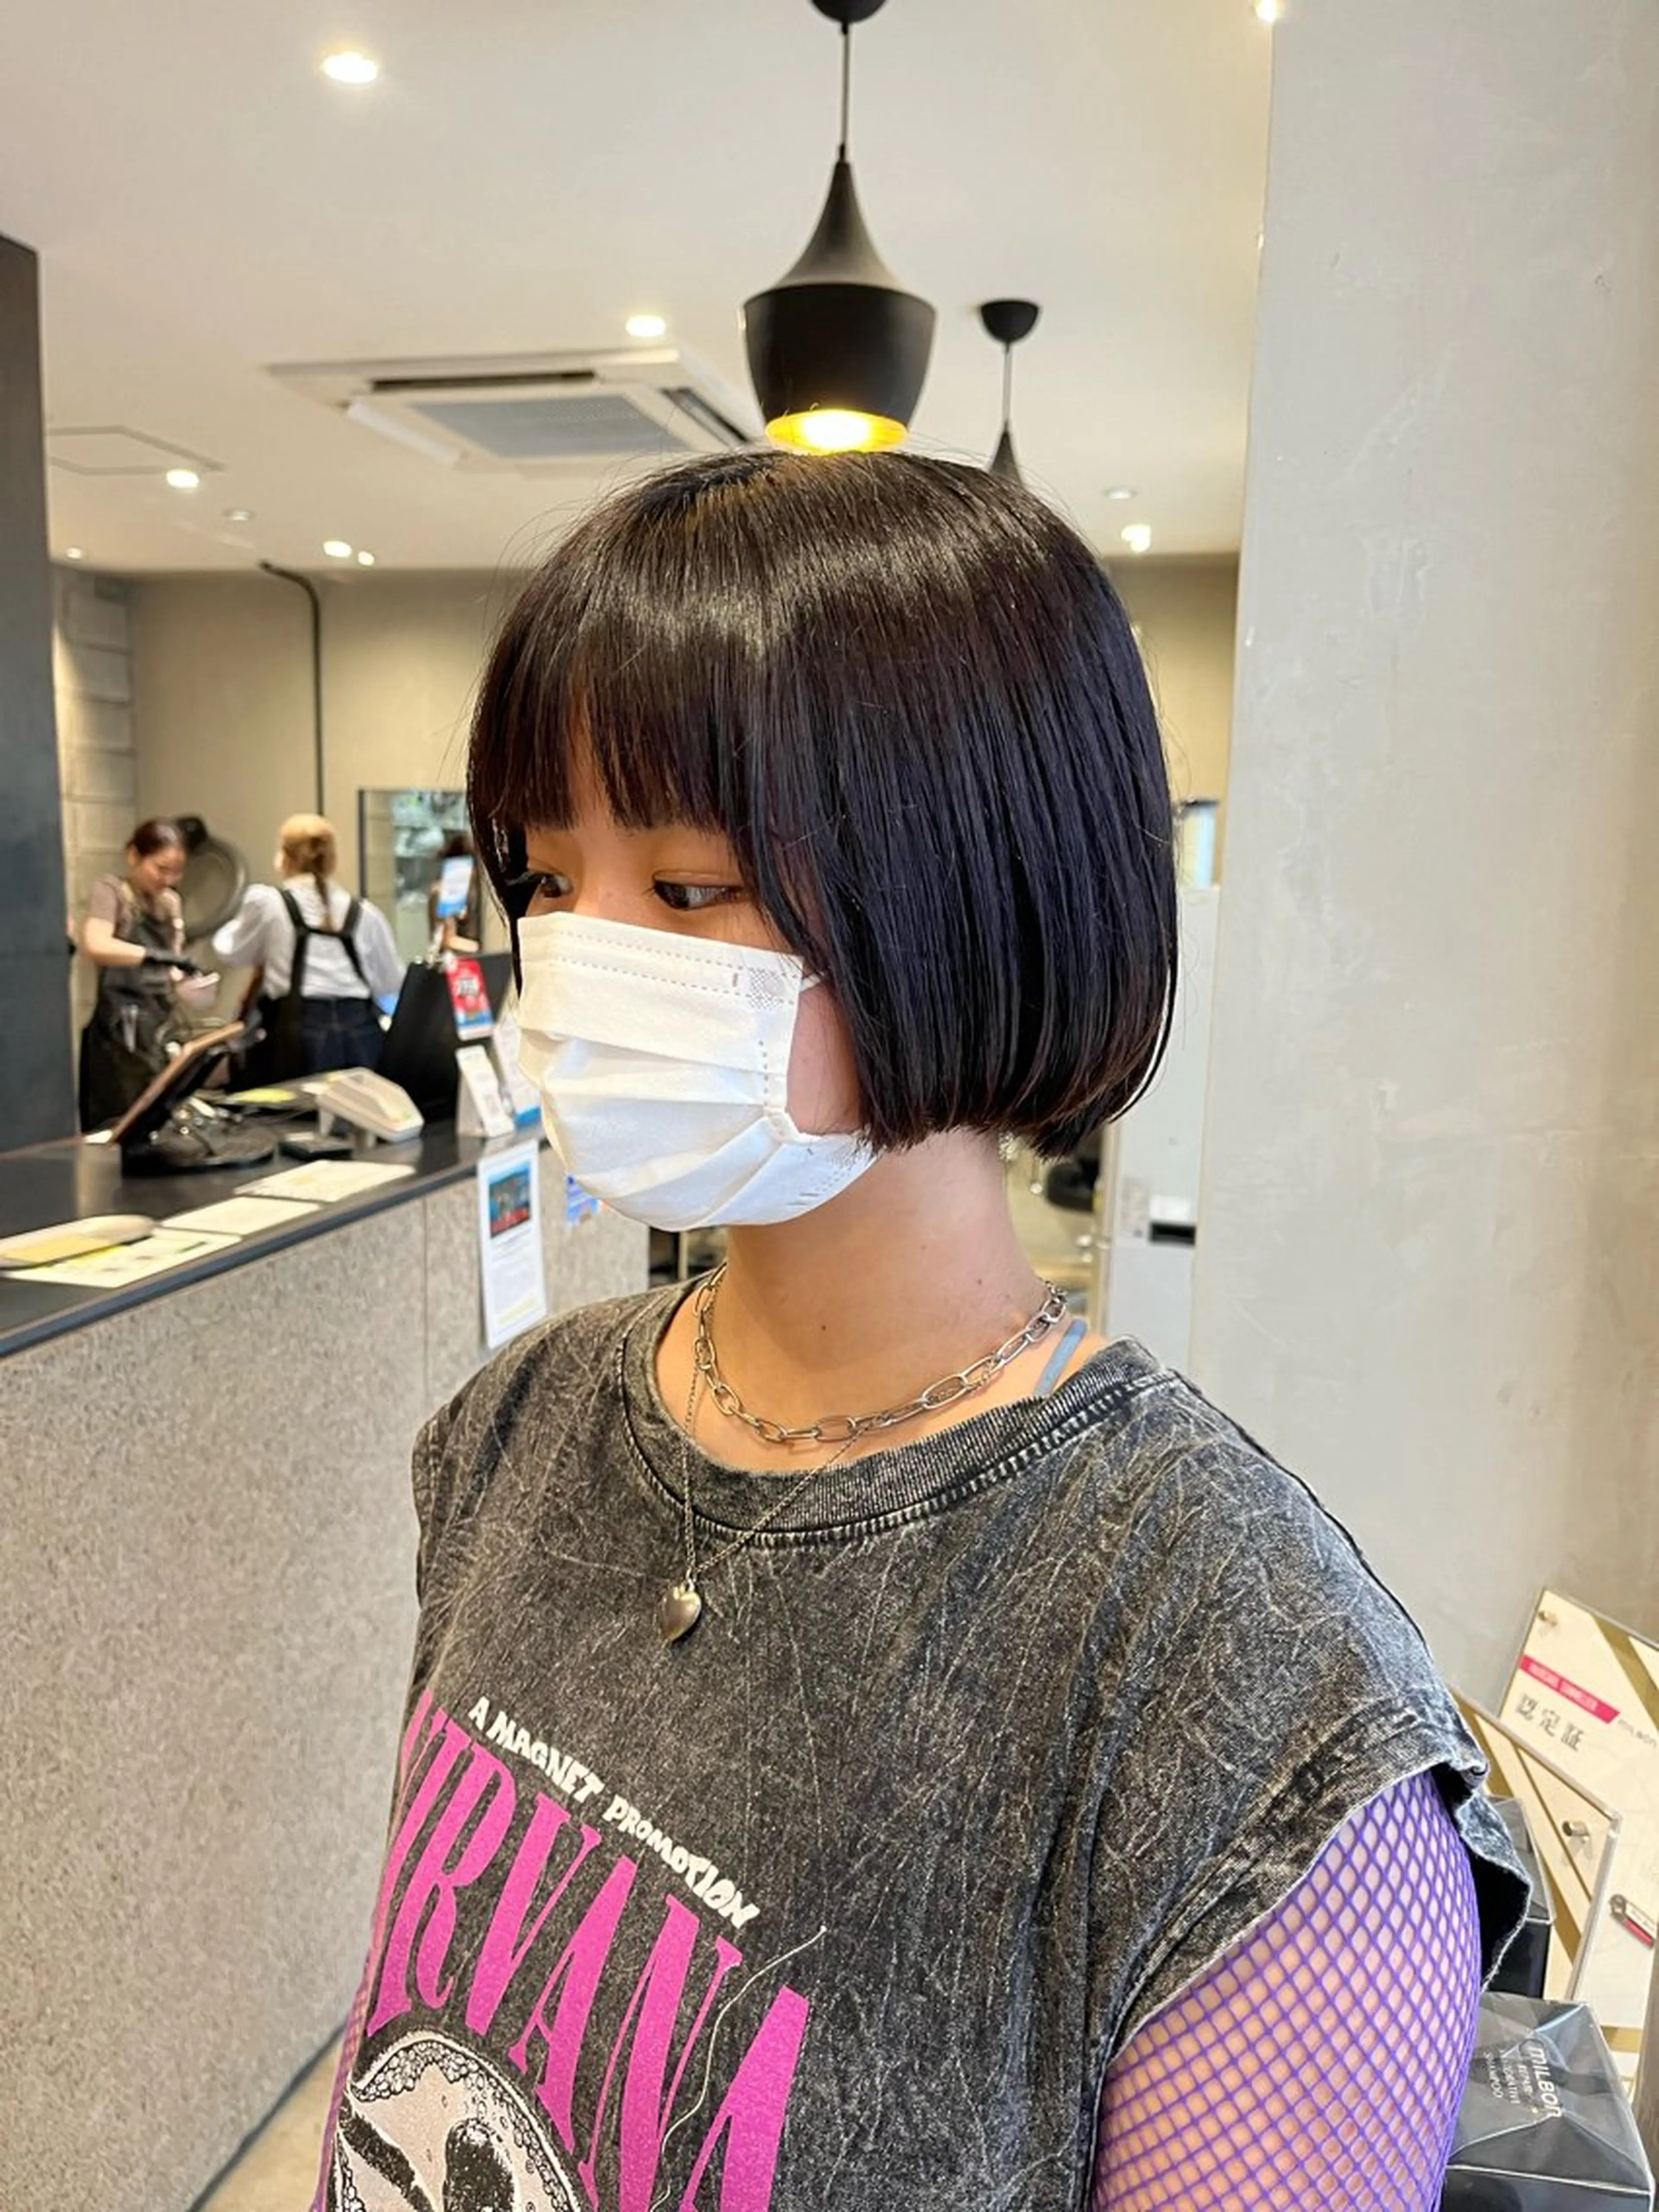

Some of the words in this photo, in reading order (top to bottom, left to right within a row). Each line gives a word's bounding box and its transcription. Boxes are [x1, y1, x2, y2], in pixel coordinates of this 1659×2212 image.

[468, 1696, 489, 1730] A
[486, 1711, 604, 1803] MAGNET
[603, 1794, 760, 1929] PROMOTION
